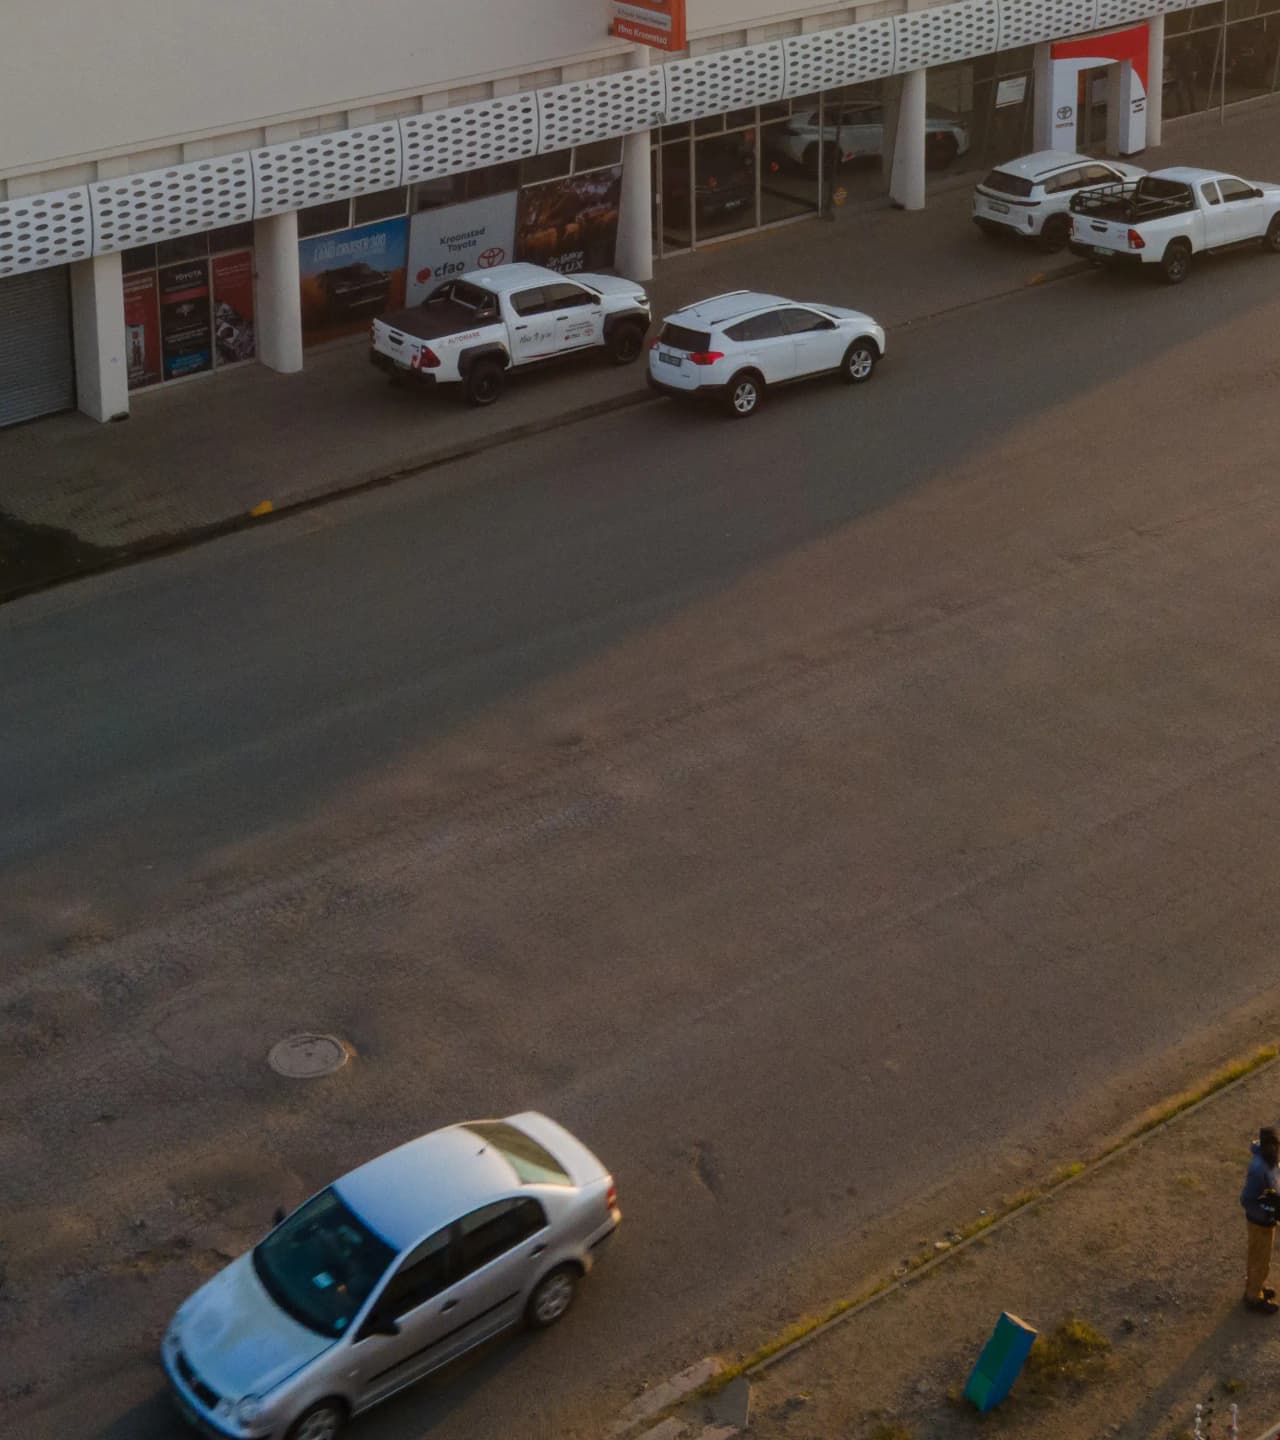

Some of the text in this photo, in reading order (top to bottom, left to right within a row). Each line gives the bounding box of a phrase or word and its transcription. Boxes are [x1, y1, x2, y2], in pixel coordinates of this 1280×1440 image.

[439, 227, 486, 245] Kroonstad
[447, 239, 477, 252] Toyota
[433, 261, 465, 278] cfao
